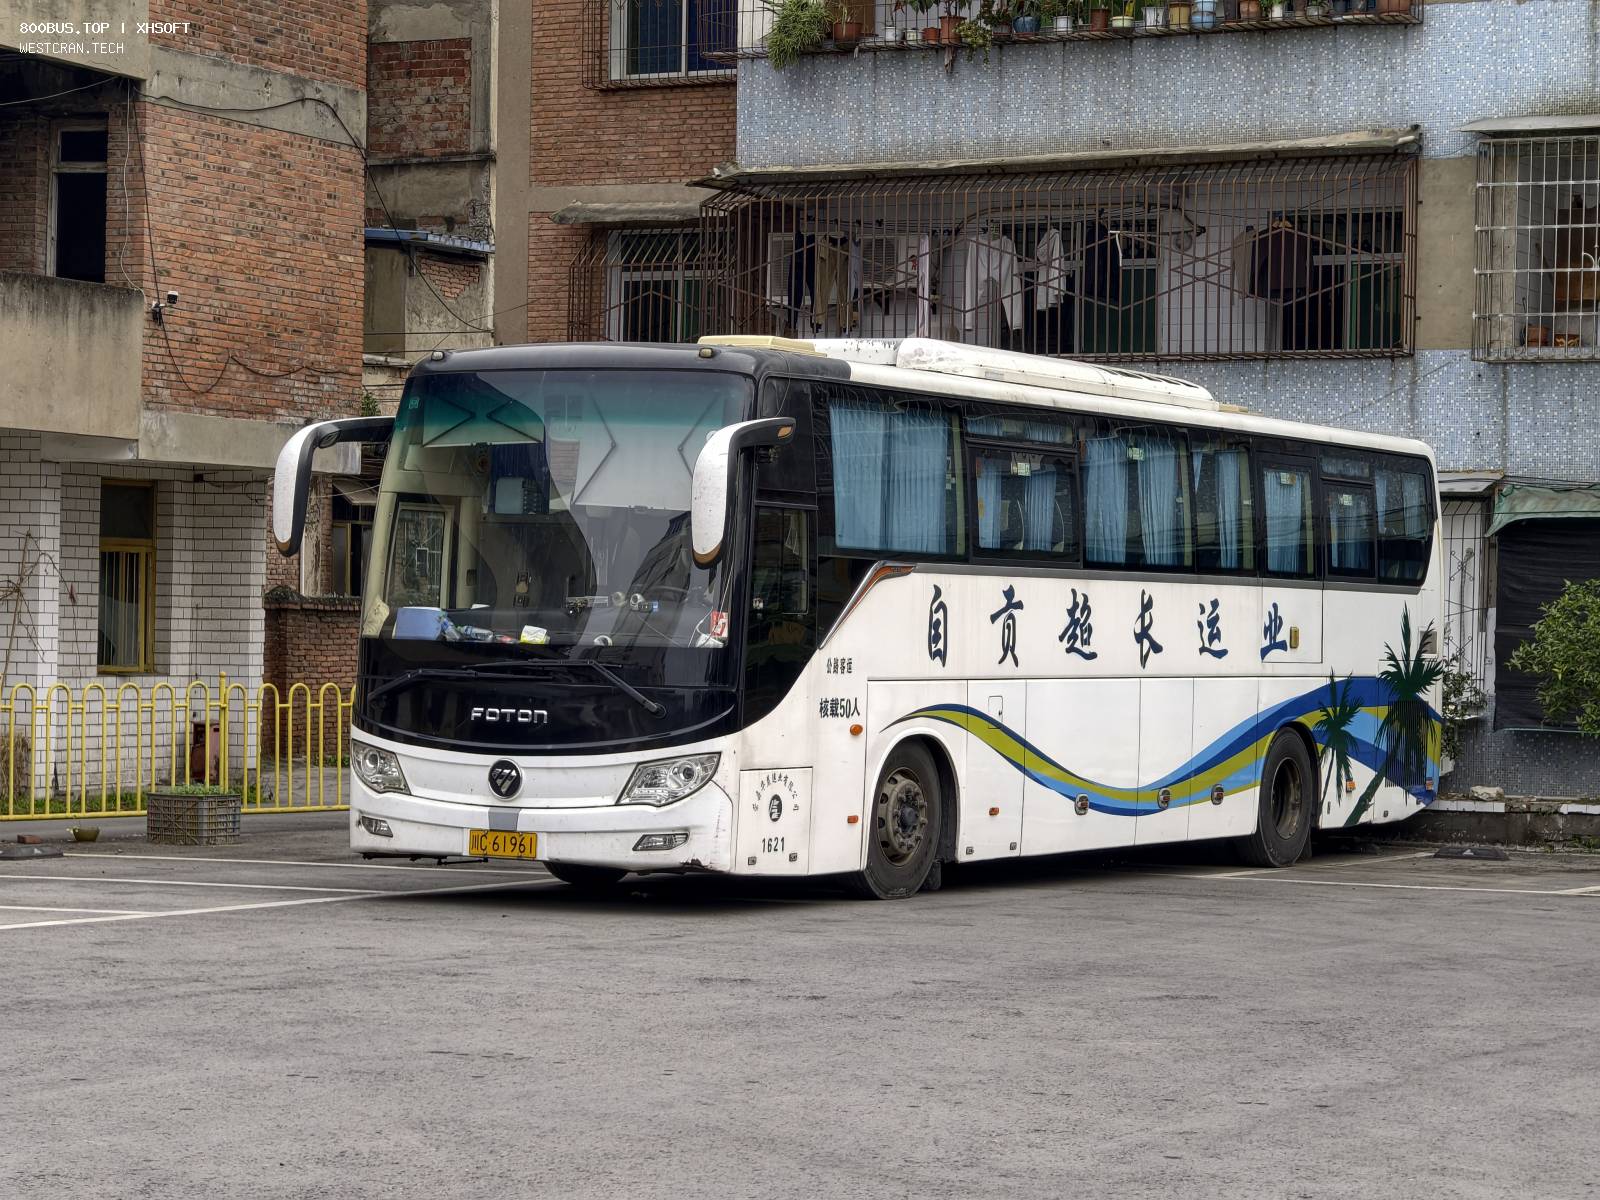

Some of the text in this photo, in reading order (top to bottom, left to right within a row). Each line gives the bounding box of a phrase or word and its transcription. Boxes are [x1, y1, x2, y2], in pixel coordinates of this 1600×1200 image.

[927, 583, 1288, 669] 自贡超长运业
[470, 707, 548, 723] FOTON
[819, 697, 861, 719] 核载50人
[761, 836, 785, 854] 1621
